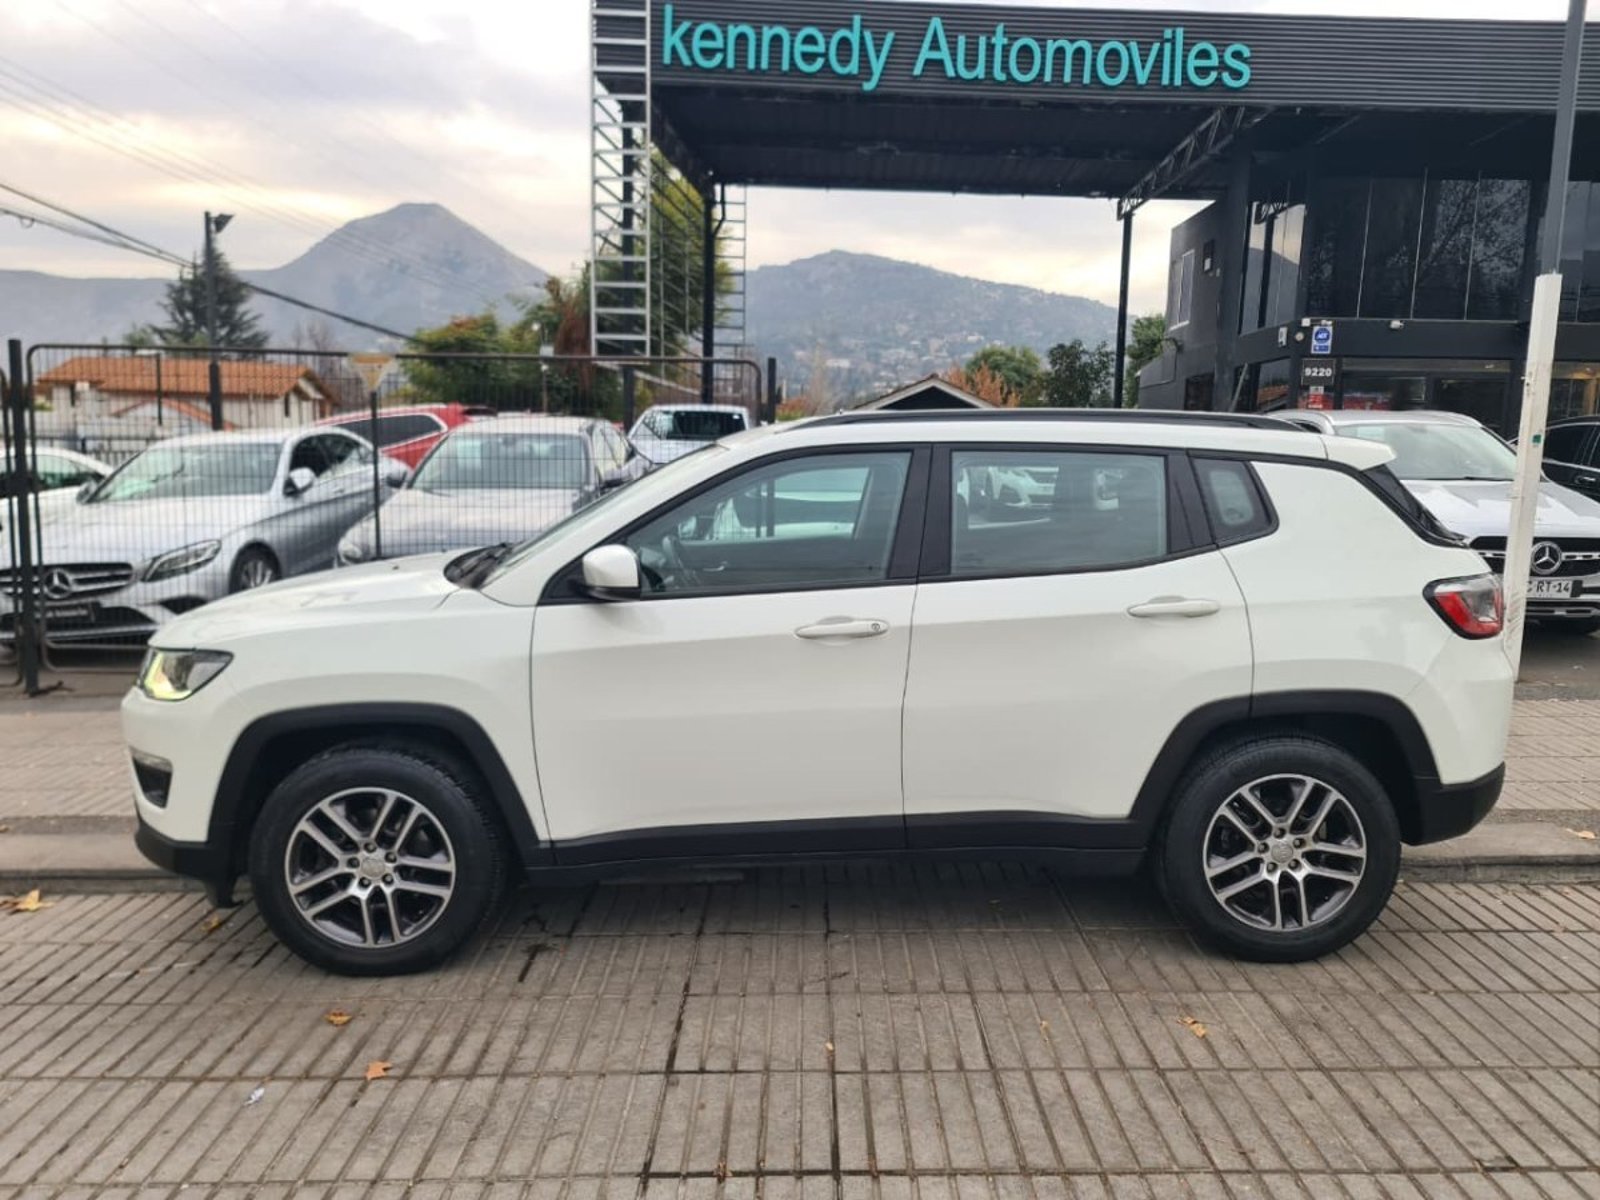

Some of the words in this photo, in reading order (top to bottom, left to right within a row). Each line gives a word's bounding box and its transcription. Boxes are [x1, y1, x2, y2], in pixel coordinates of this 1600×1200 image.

[663, 4, 895, 92] kennedy
[914, 16, 1251, 90] Automoviles
[1304, 367, 1332, 377] 9220
